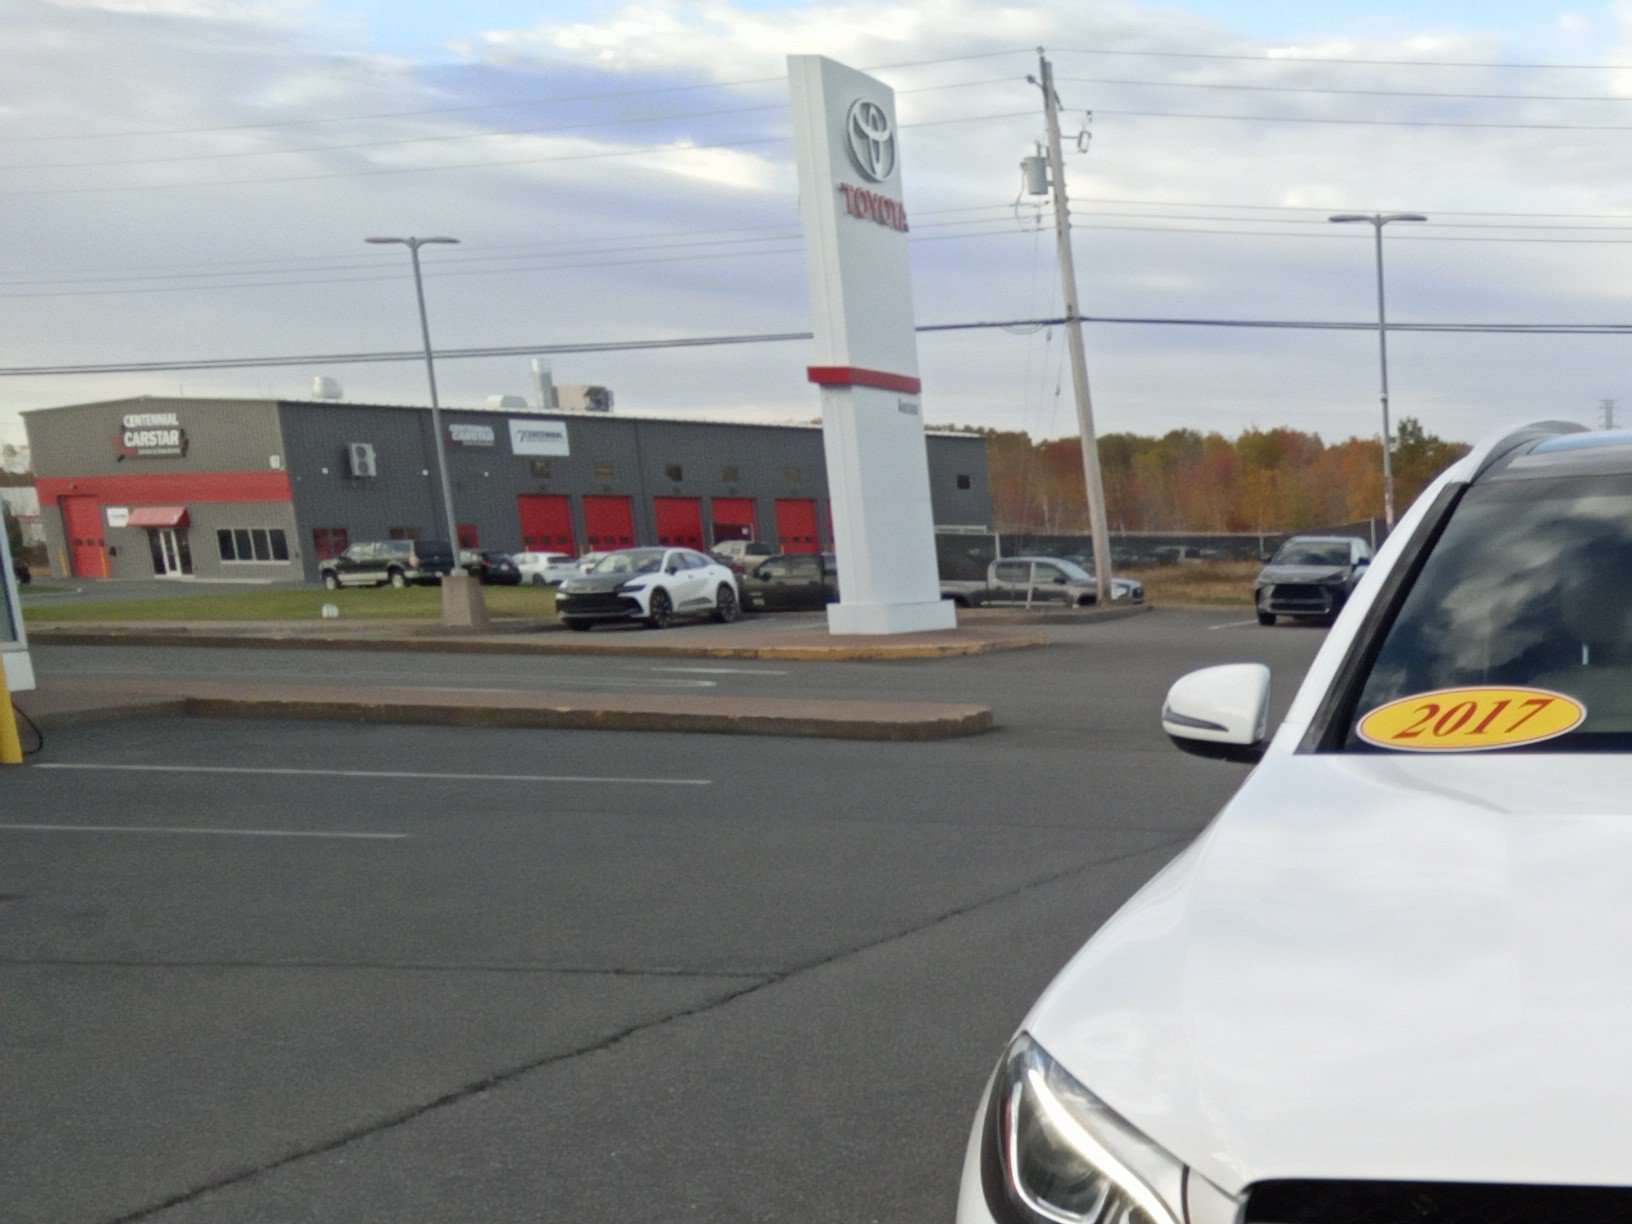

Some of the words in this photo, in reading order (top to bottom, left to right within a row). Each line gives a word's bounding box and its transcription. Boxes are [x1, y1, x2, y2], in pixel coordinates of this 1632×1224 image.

[838, 183, 909, 232] TOYOTA
[124, 430, 179, 447] CARSTAR
[1391, 698, 1556, 741] 2017
